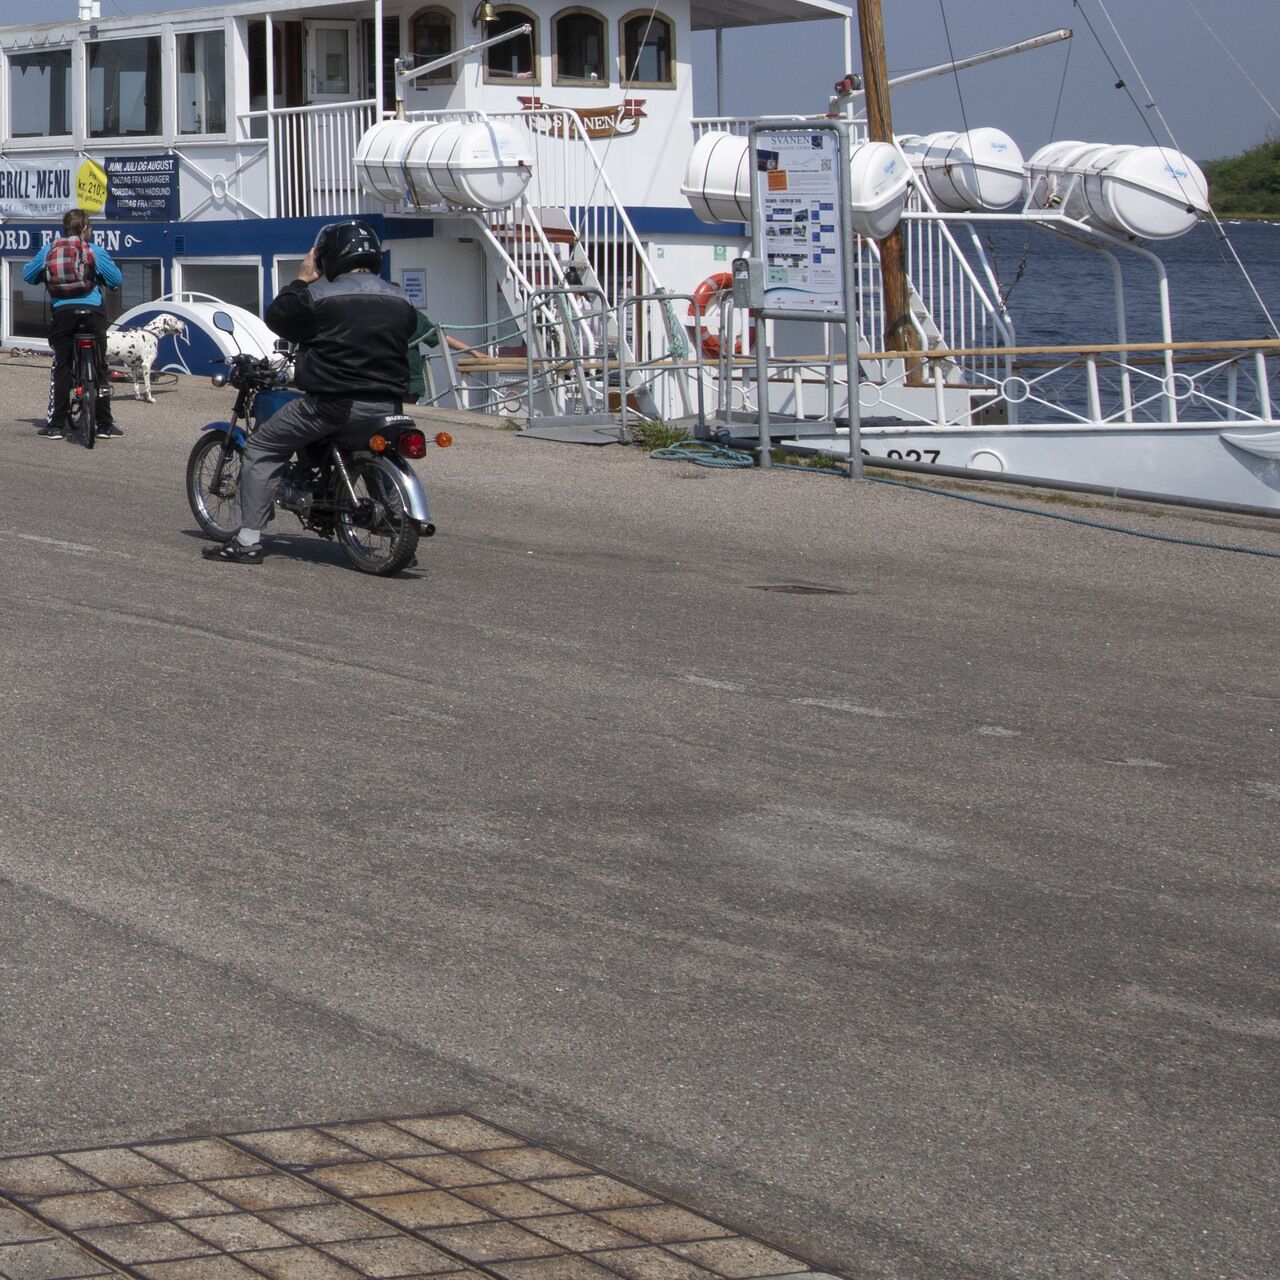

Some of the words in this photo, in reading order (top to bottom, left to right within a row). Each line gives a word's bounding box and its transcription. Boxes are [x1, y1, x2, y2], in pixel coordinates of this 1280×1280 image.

[553, 114, 615, 130] SNEN
[771, 135, 810, 145] SVANEN
[123, 161, 137, 171] JULI
[147, 160, 174, 170] AUGUST
[132, 176, 142, 184] FRA
[142, 175, 170, 183] MARIAGER
[137, 200, 147, 208] FRA
[41, 230, 121, 251] FAEN
